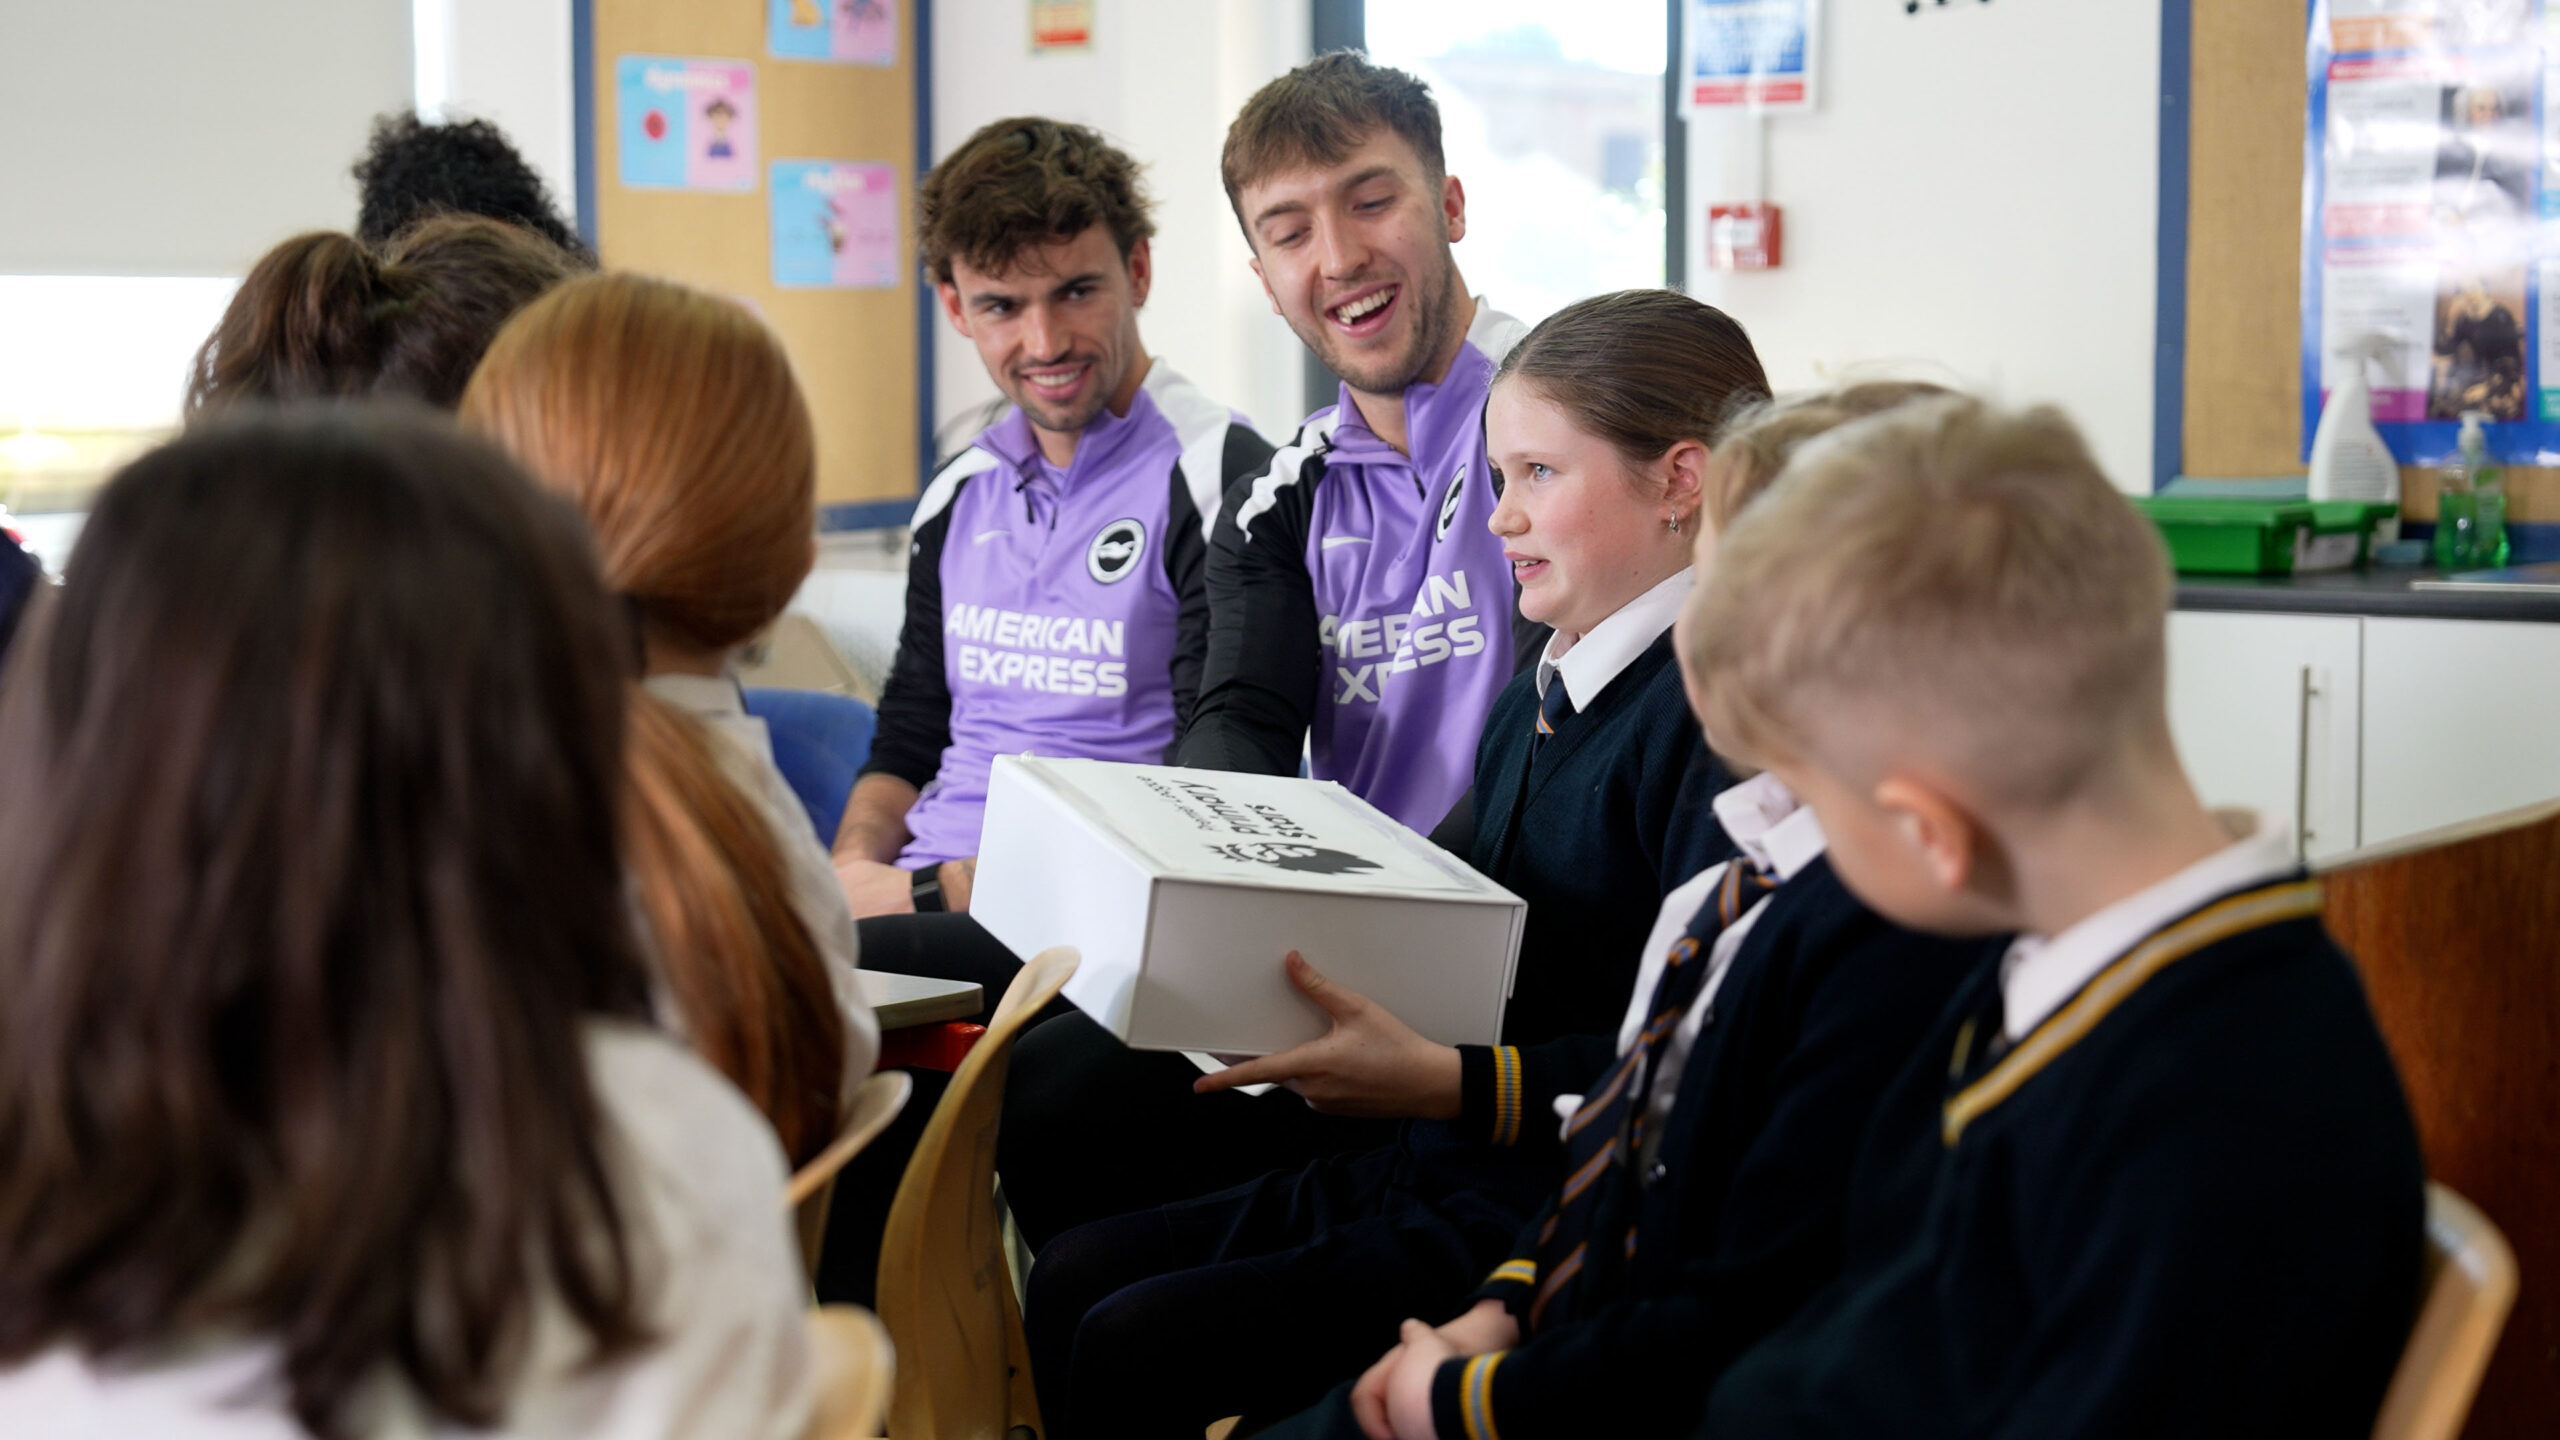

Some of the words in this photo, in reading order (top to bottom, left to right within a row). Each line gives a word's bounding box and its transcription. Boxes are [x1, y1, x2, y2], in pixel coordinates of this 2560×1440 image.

[945, 602, 1125, 657] AMERICAN
[1319, 570, 1472, 659] AERAN
[958, 644, 1128, 697] EXPRESS
[1334, 615, 1486, 704] XESS
[1171, 780, 1271, 836] Primary
[1244, 803, 1318, 839] Stars
